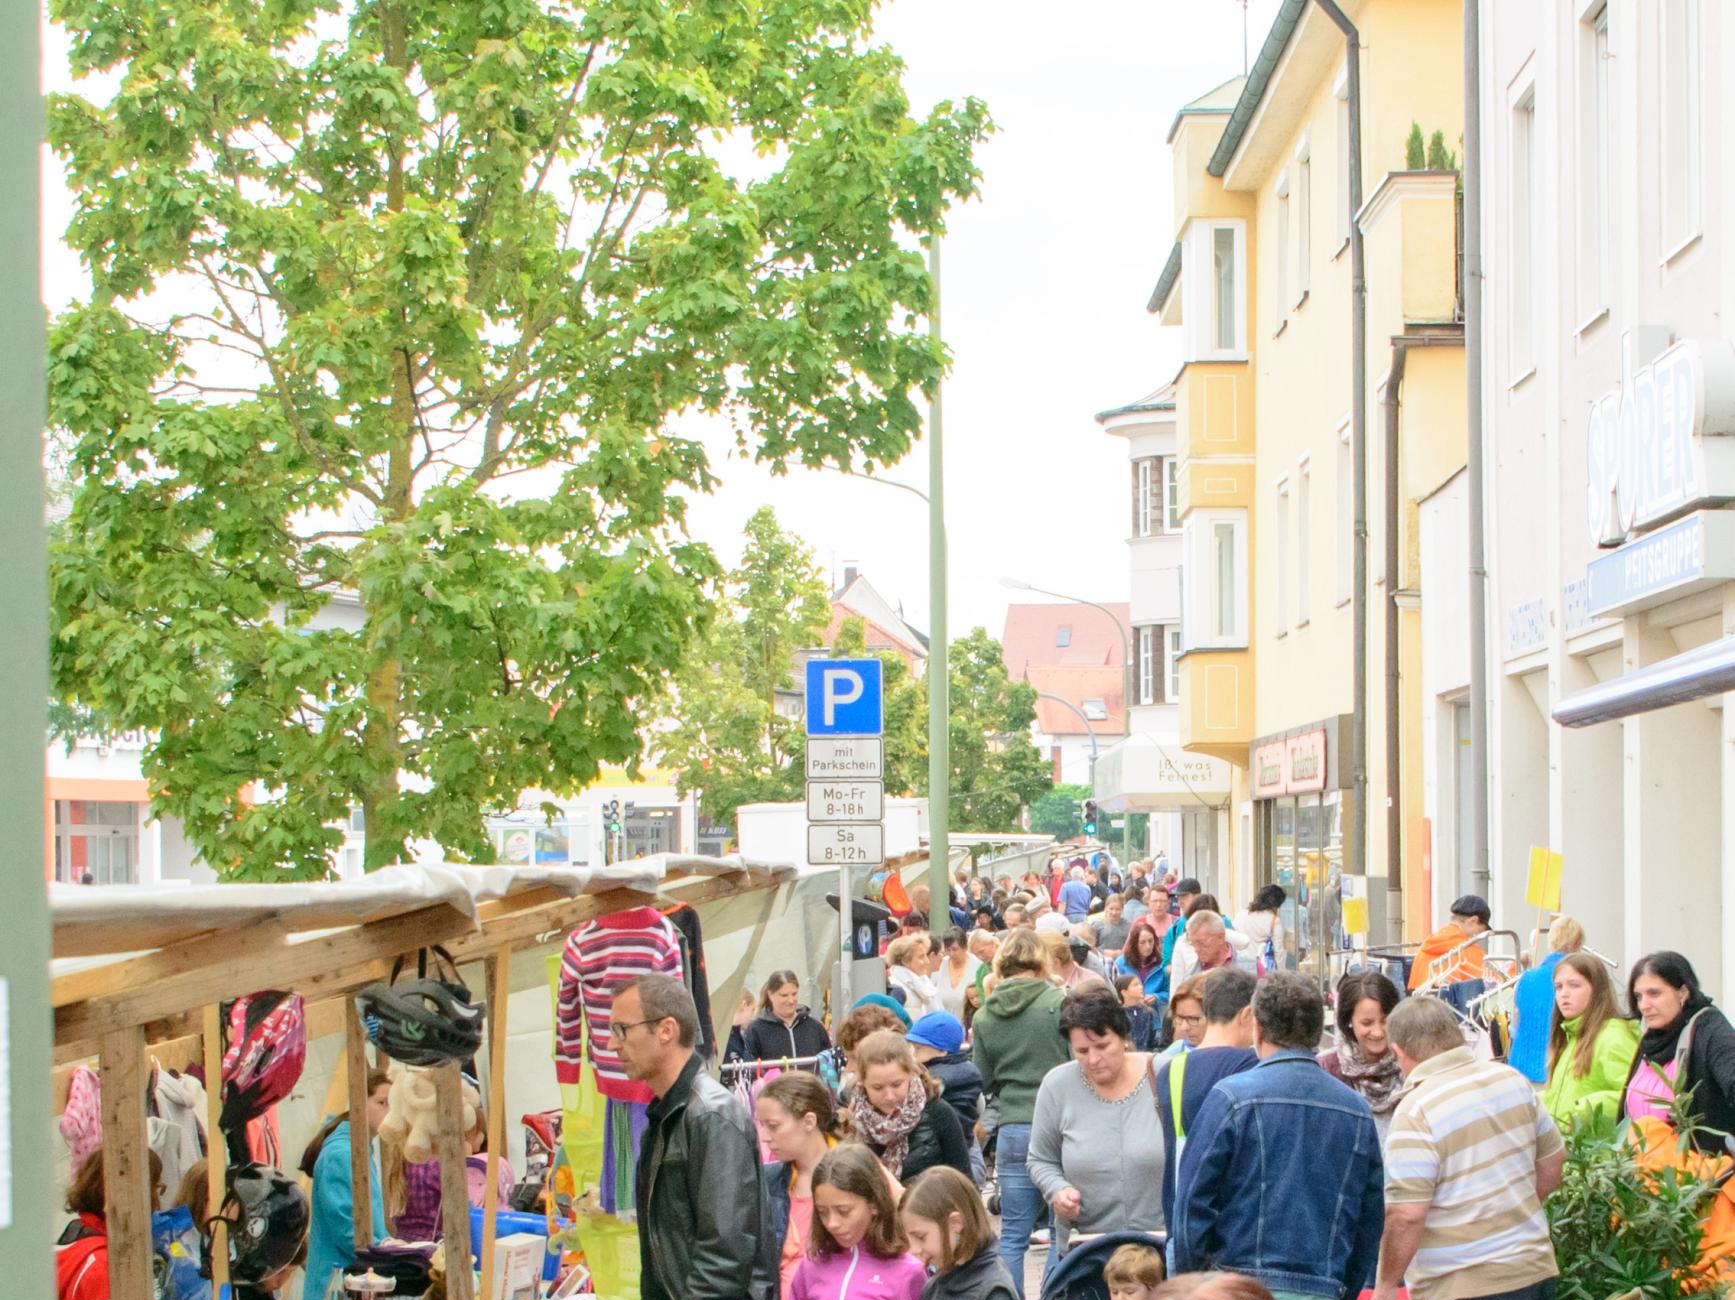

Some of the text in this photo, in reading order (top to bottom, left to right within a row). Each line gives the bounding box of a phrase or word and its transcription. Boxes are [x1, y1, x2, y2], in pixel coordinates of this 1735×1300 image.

[823, 669, 864, 726] P
[834, 746, 853, 757] mit
[812, 760, 876, 770] Parkschein
[1183, 762, 1211, 770] was
[823, 788, 866, 801] Mo-Fr
[836, 829, 854, 842] Sa
